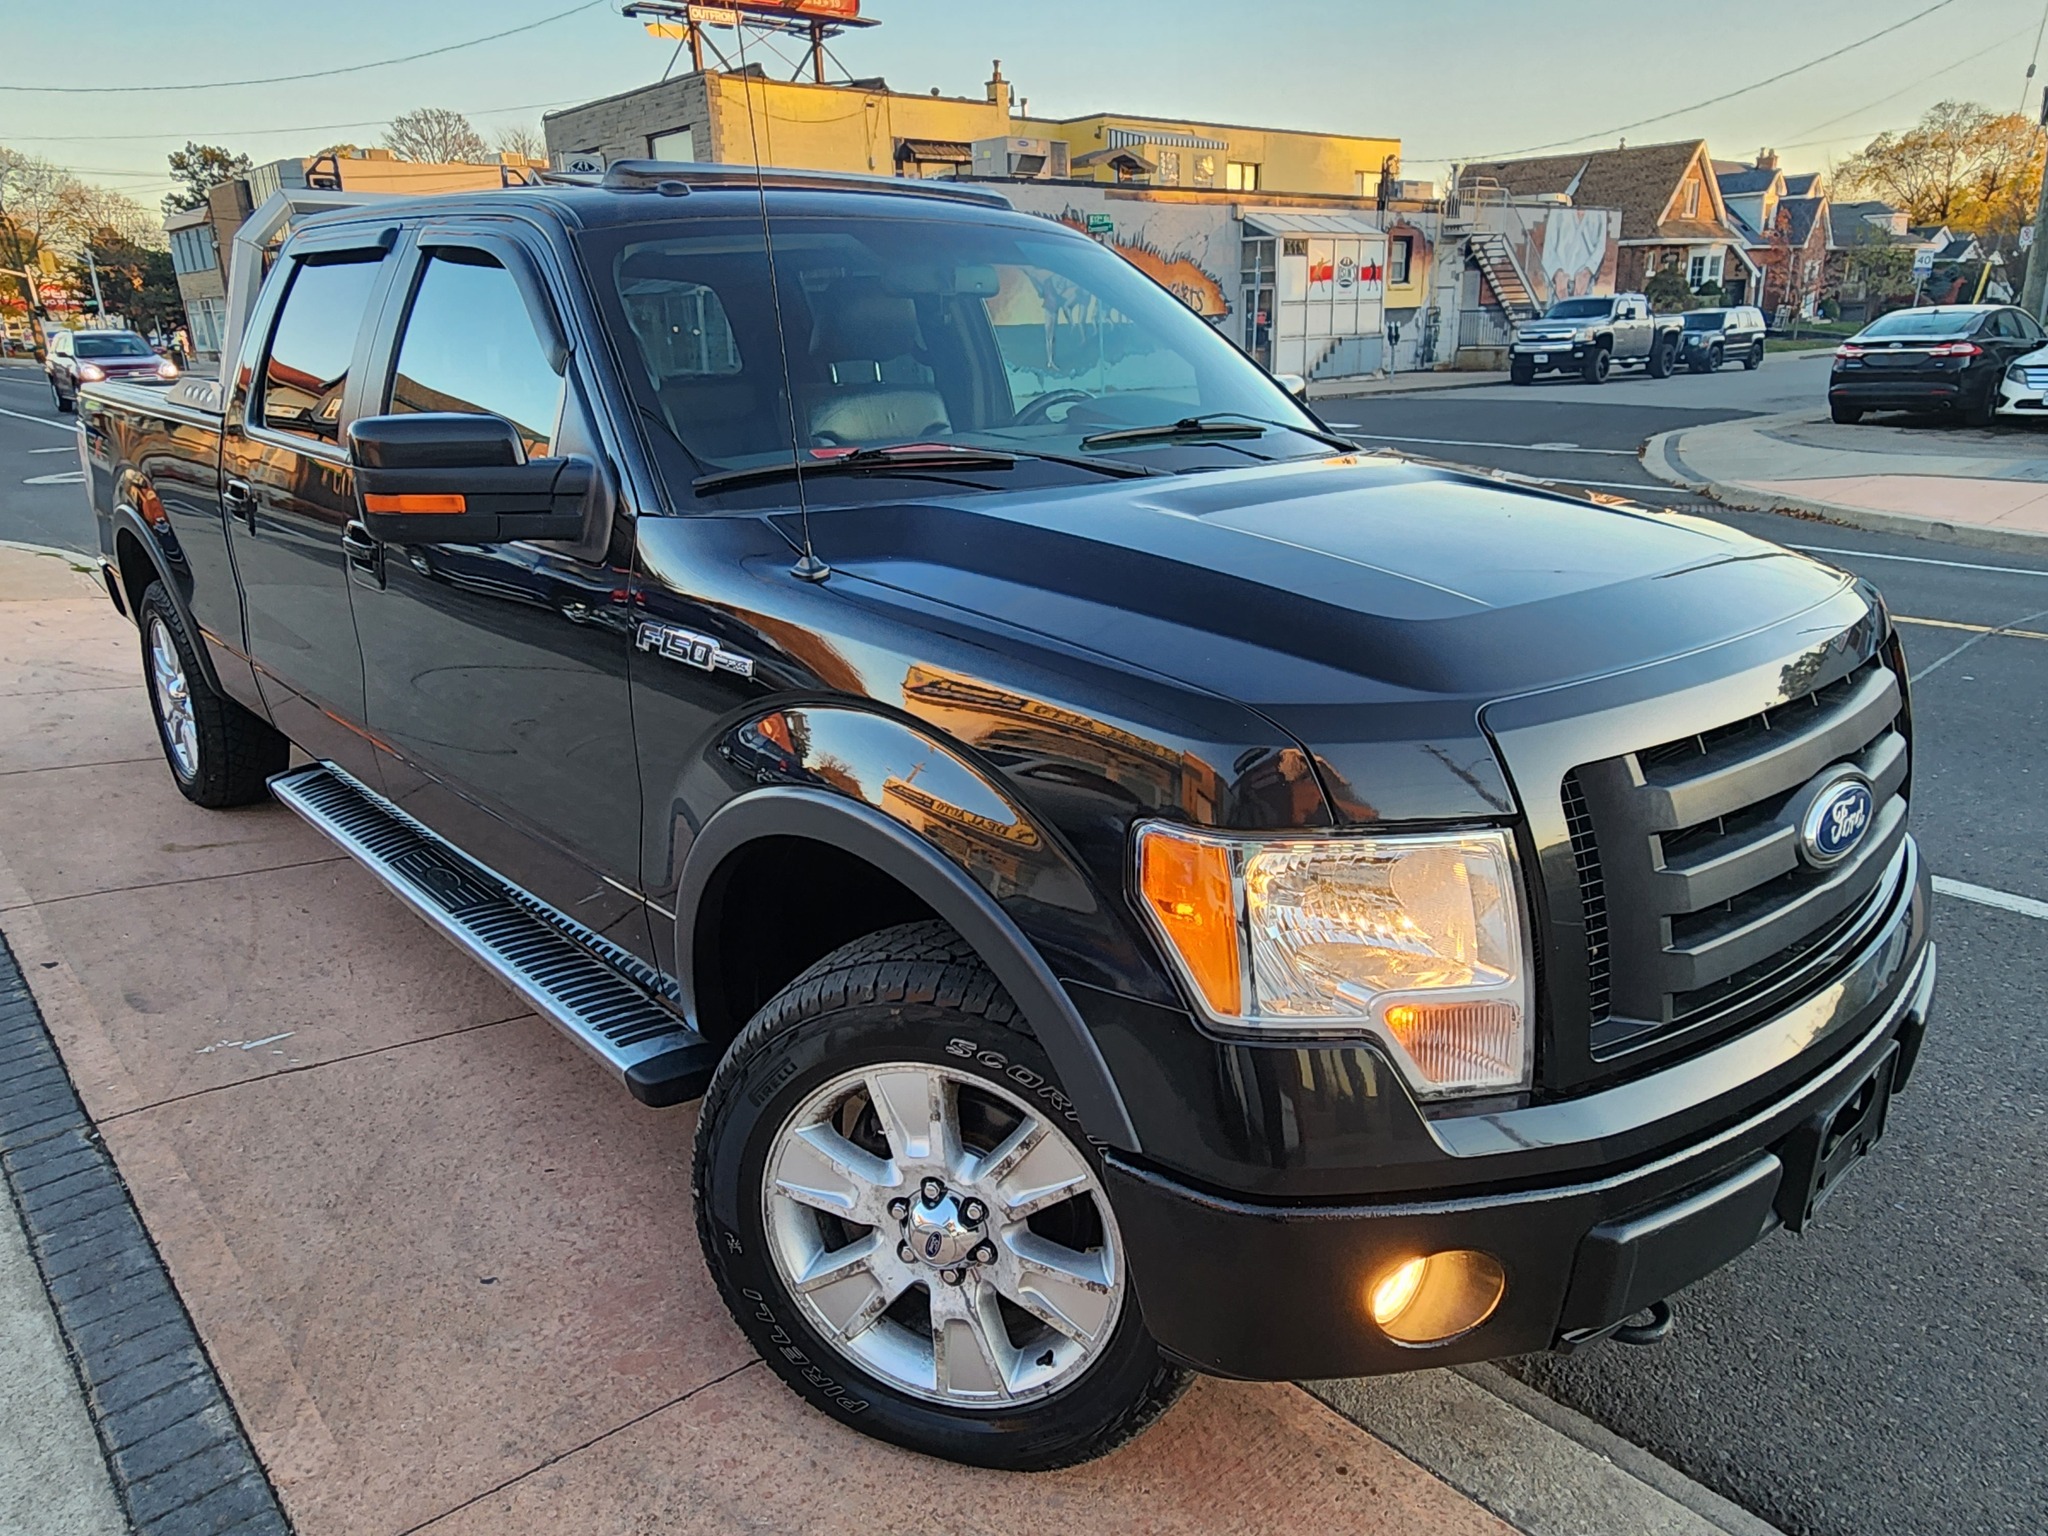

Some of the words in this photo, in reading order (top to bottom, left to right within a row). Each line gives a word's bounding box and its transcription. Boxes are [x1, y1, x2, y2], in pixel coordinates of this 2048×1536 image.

[1917, 255, 1932, 265] 40
[637, 623, 718, 671] F-150
[1831, 796, 1866, 844] Ford
[743, 1288, 869, 1413] PIRELLI
